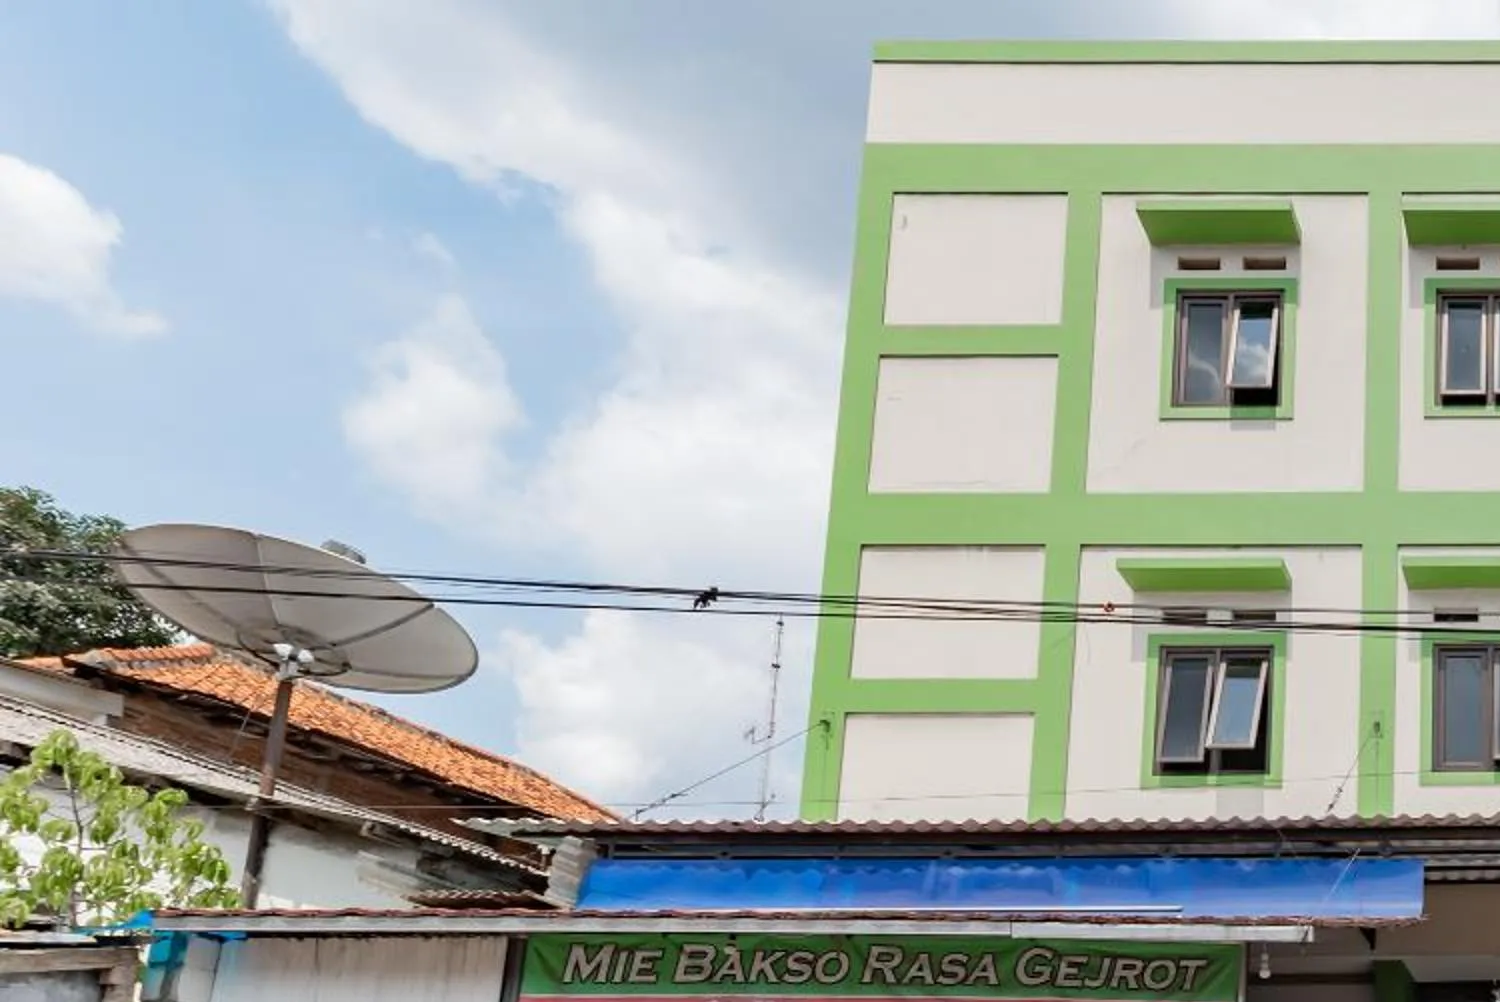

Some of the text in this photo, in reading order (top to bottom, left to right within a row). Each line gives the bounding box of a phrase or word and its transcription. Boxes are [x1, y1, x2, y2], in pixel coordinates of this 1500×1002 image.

[562, 943, 1208, 991] MIE BAKSO RASA GEJROT
